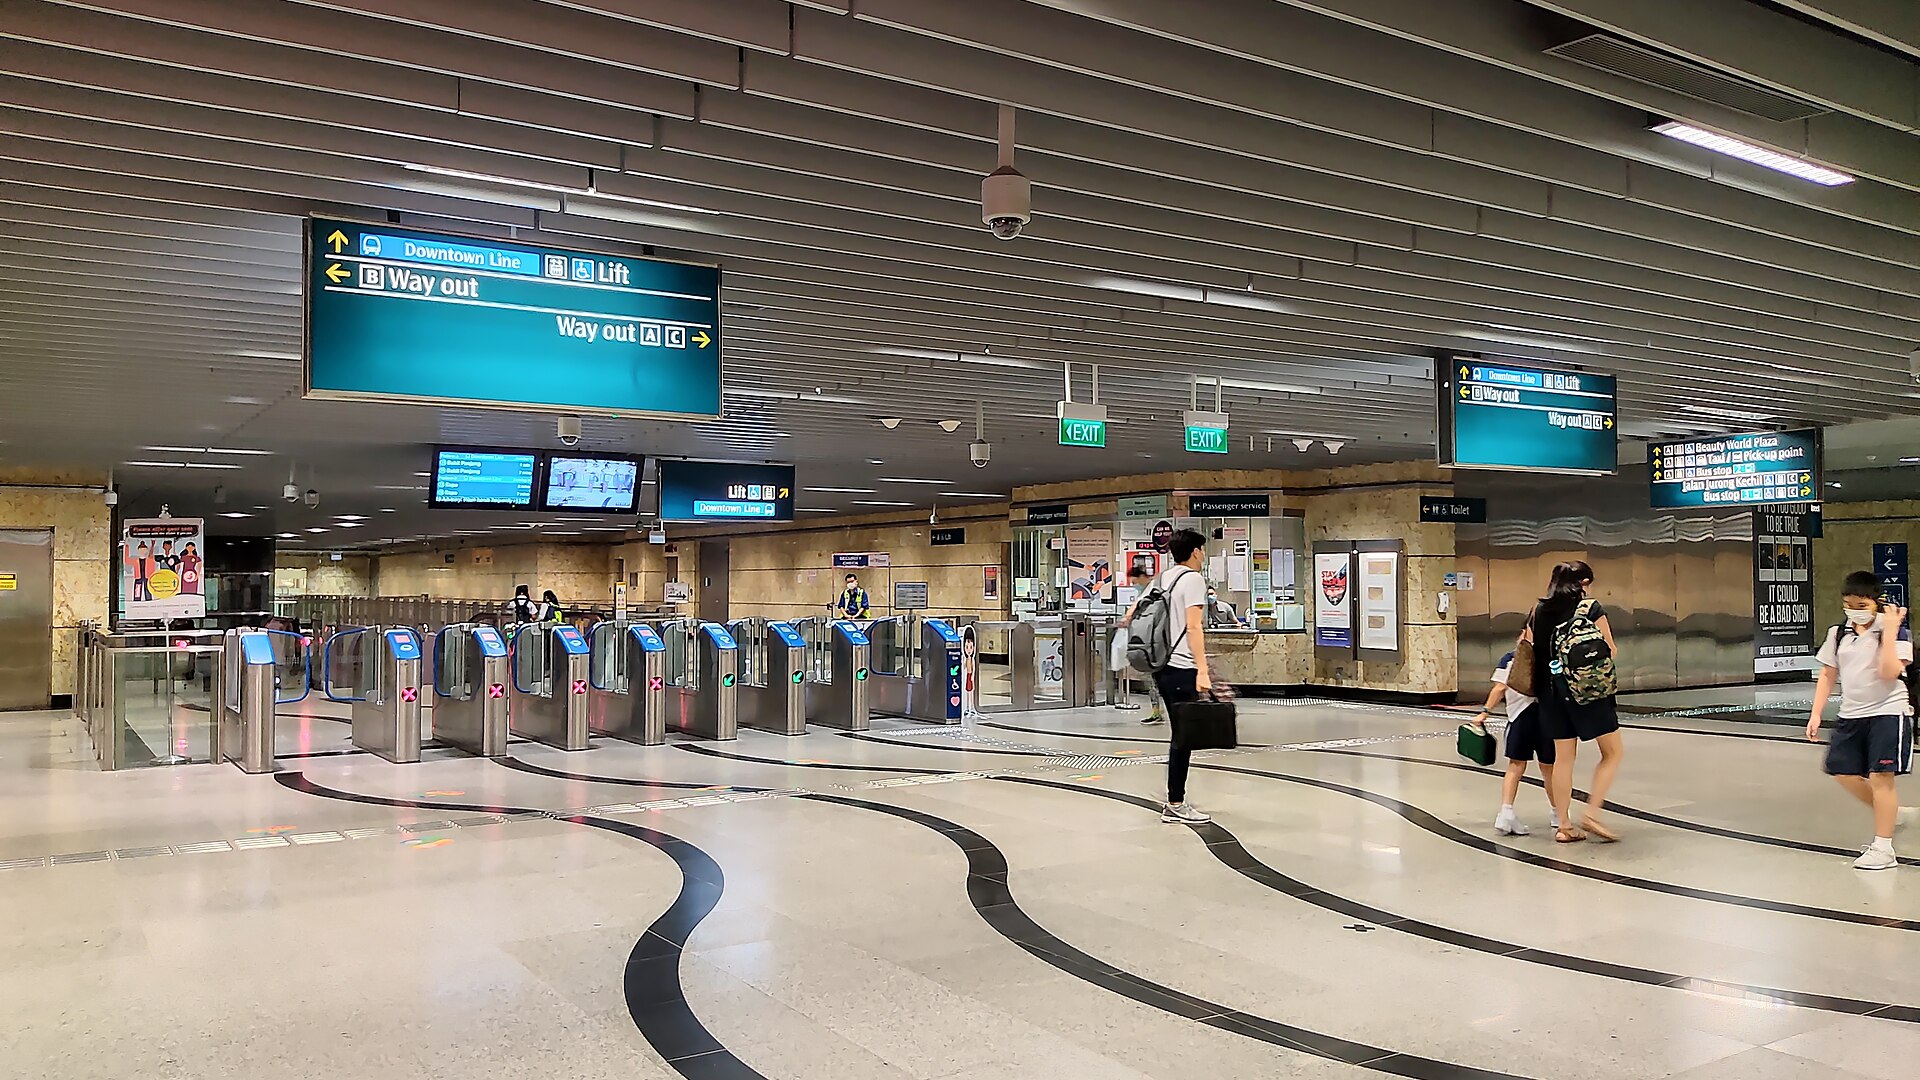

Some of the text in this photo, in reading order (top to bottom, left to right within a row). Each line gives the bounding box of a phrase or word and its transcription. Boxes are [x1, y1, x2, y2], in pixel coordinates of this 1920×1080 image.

[405, 241, 630, 284] Downtown Line Lift
[388, 267, 436, 296] Way
[440, 277, 479, 298] out
[556, 316, 598, 342] Way
[602, 324, 636, 342] out
[1489, 370, 1580, 390] Downtown Line Lift
[1483, 387, 1501, 402] Way
[1503, 390, 1520, 402] out
[1548, 412, 1566, 428] Way
[1568, 415, 1582, 428] out
[1073, 424, 1100, 442] EXIT
[1190, 430, 1215, 448] EXIT
[1696, 441, 1725, 452] Beauty
[1726, 438, 1750, 450] World
[1754, 437, 1778, 447] Plaza
[1707, 453, 1726, 464] Taxi
[1744, 450, 1777, 462] Pick-up
[1778, 447, 1803, 460] point
[1696, 468, 1713, 477] Bus
[1714, 466, 1732, 477] stop
[728, 484, 746, 498] Lift
[1682, 480, 1704, 492] Jalan
[1706, 478, 1735, 490] Jurong
[1736, 475, 1762, 488] Kechil
[1703, 492, 1717, 502] Bus
[1717, 490, 1740, 502] stop
[700, 503, 761, 513] Downtown Line
[1202, 502, 1266, 511] Passenger service
[1450, 505, 1470, 515] Toilet
[1766, 515, 1800, 533] TO BE TRUE
[1769, 585, 1798, 602] IT COULD
[1760, 604, 1808, 623] BE A BAD SIGN
